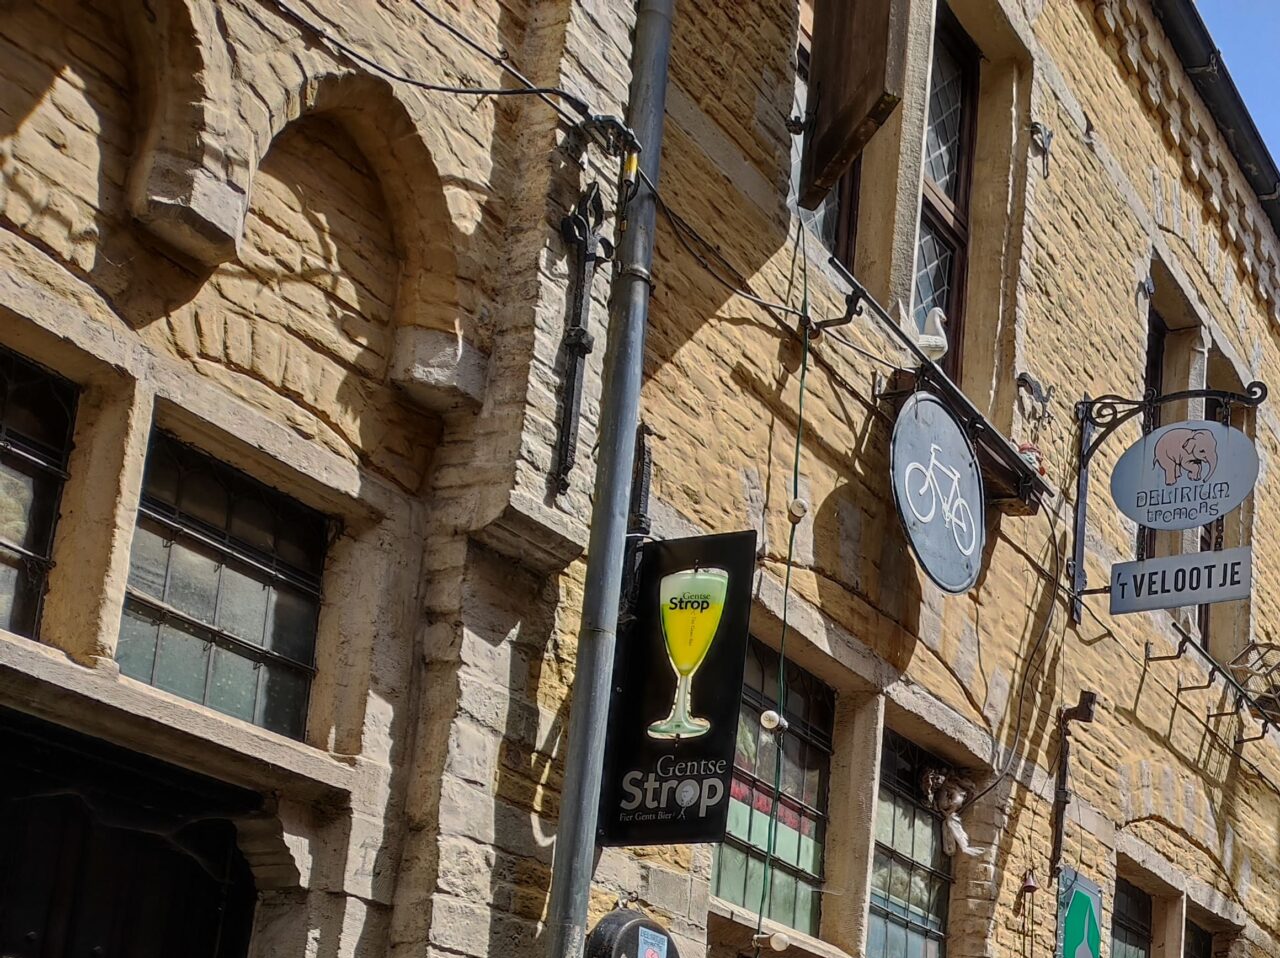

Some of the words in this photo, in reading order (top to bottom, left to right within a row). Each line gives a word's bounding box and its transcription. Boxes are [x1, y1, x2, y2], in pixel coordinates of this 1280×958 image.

[1136, 481, 1230, 508] DELIRIUM
[1132, 562, 1242, 598] VELOOTJE
[669, 596, 710, 613] Strop
[682, 592, 711, 600] Gentse
[657, 755, 727, 777] Gentse
[620, 770, 724, 817] Strop
